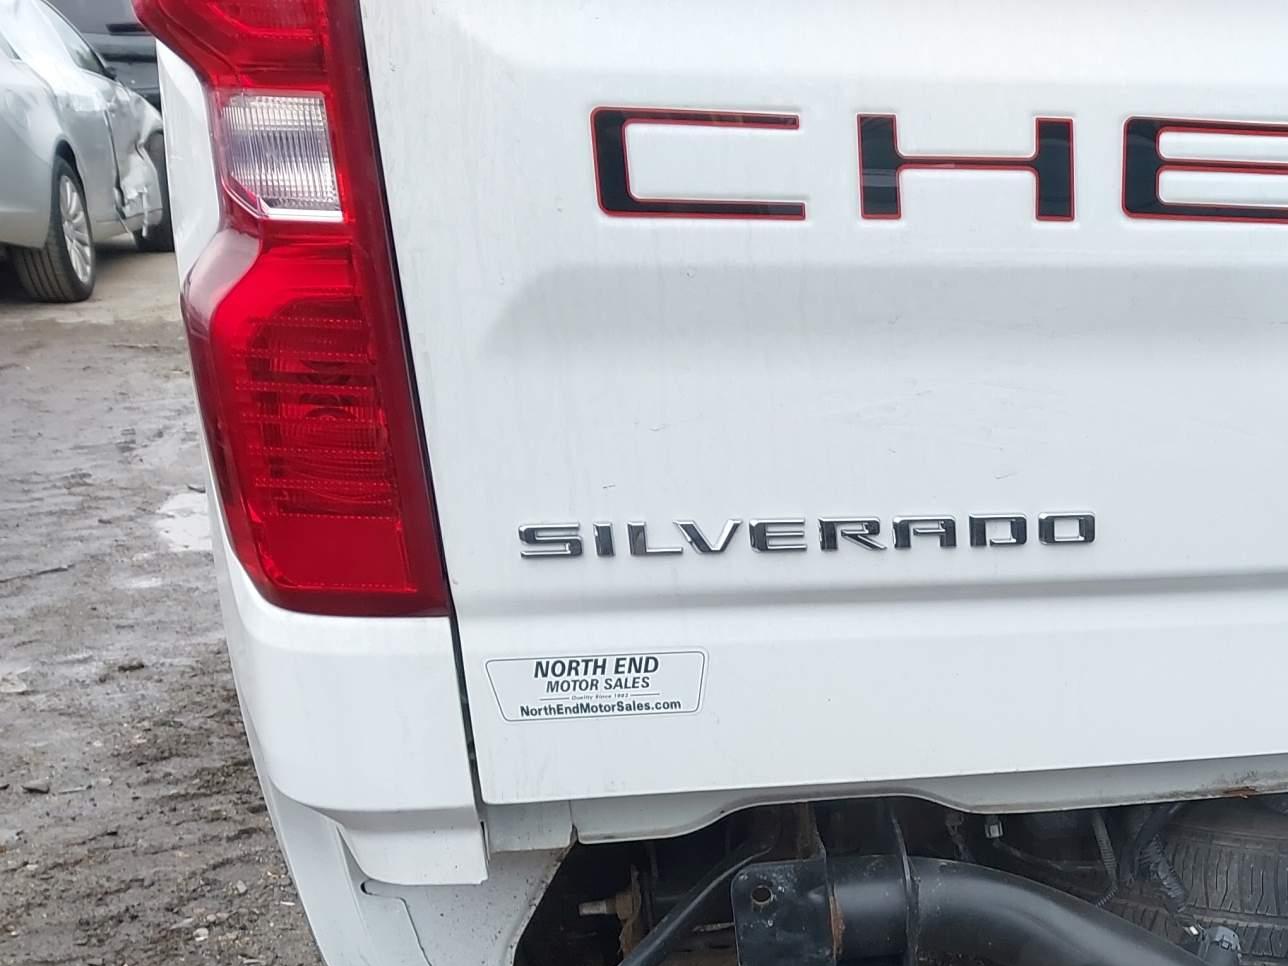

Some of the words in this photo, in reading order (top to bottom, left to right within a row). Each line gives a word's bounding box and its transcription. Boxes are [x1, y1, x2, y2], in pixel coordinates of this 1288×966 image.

[518, 511, 1096, 559] SILVERADO
[534, 657, 607, 679] NORTH
[613, 655, 660, 676] END
[545, 678, 600, 694] MOTOR
[603, 675, 651, 691] SALES
[520, 699, 682, 718] NorthEndMotorSales.com
